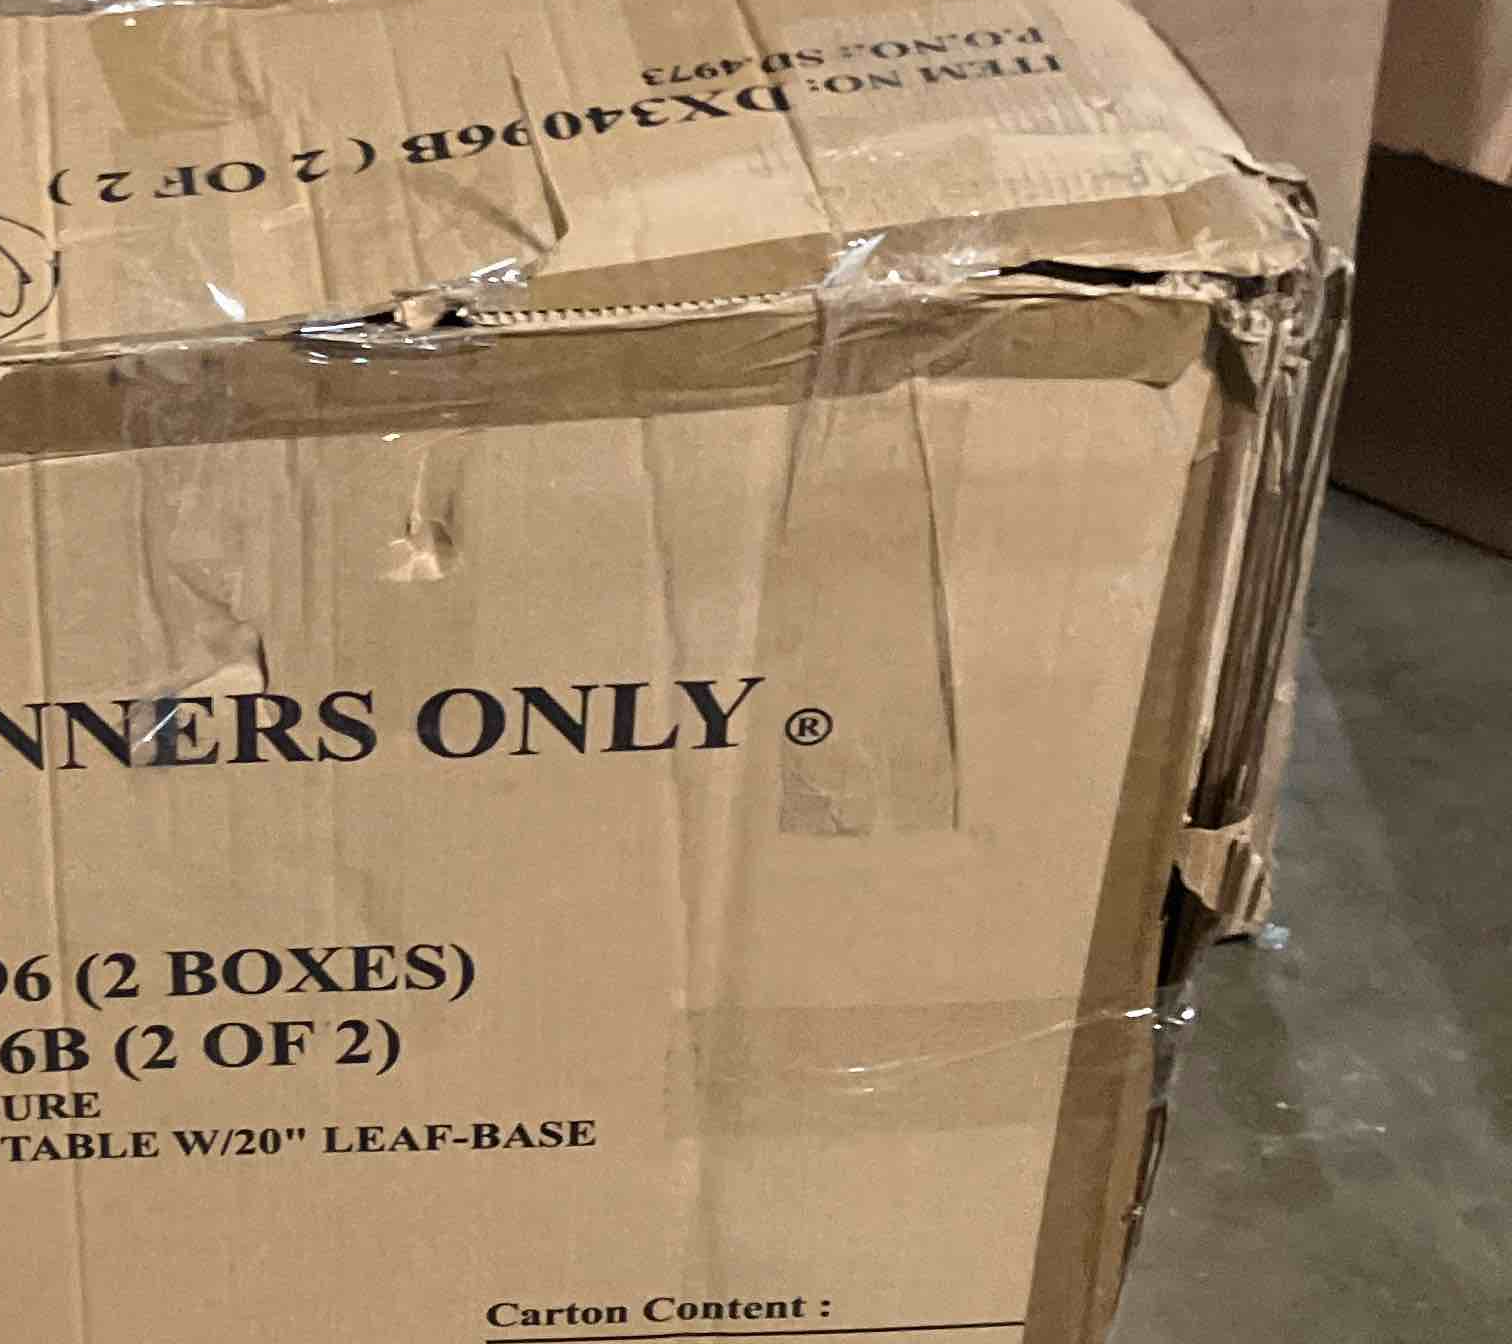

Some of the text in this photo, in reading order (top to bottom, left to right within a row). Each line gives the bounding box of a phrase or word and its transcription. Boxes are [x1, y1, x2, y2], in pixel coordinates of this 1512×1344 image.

[807, 72, 905, 94] NO:
[919, 54, 1062, 84] ITEM
[401, 83, 790, 164] DX34096B
[97, 168, 139, 200] 2
[153, 160, 266, 202] OF
[292, 148, 338, 184] 2
[415, 673, 766, 760] ONLY
[75, 951, 139, 1011] (2
[166, 943, 476, 1002] BOXES)
[114, 1023, 178, 1082] (2
[203, 1020, 315, 1068] OF
[335, 1018, 401, 1075] 2)
[1, 1131, 158, 1163] TABLE
[322, 1119, 597, 1155] LEAF-BASE
[486, 1301, 628, 1329] Carton
[643, 1293, 806, 1323] Content
